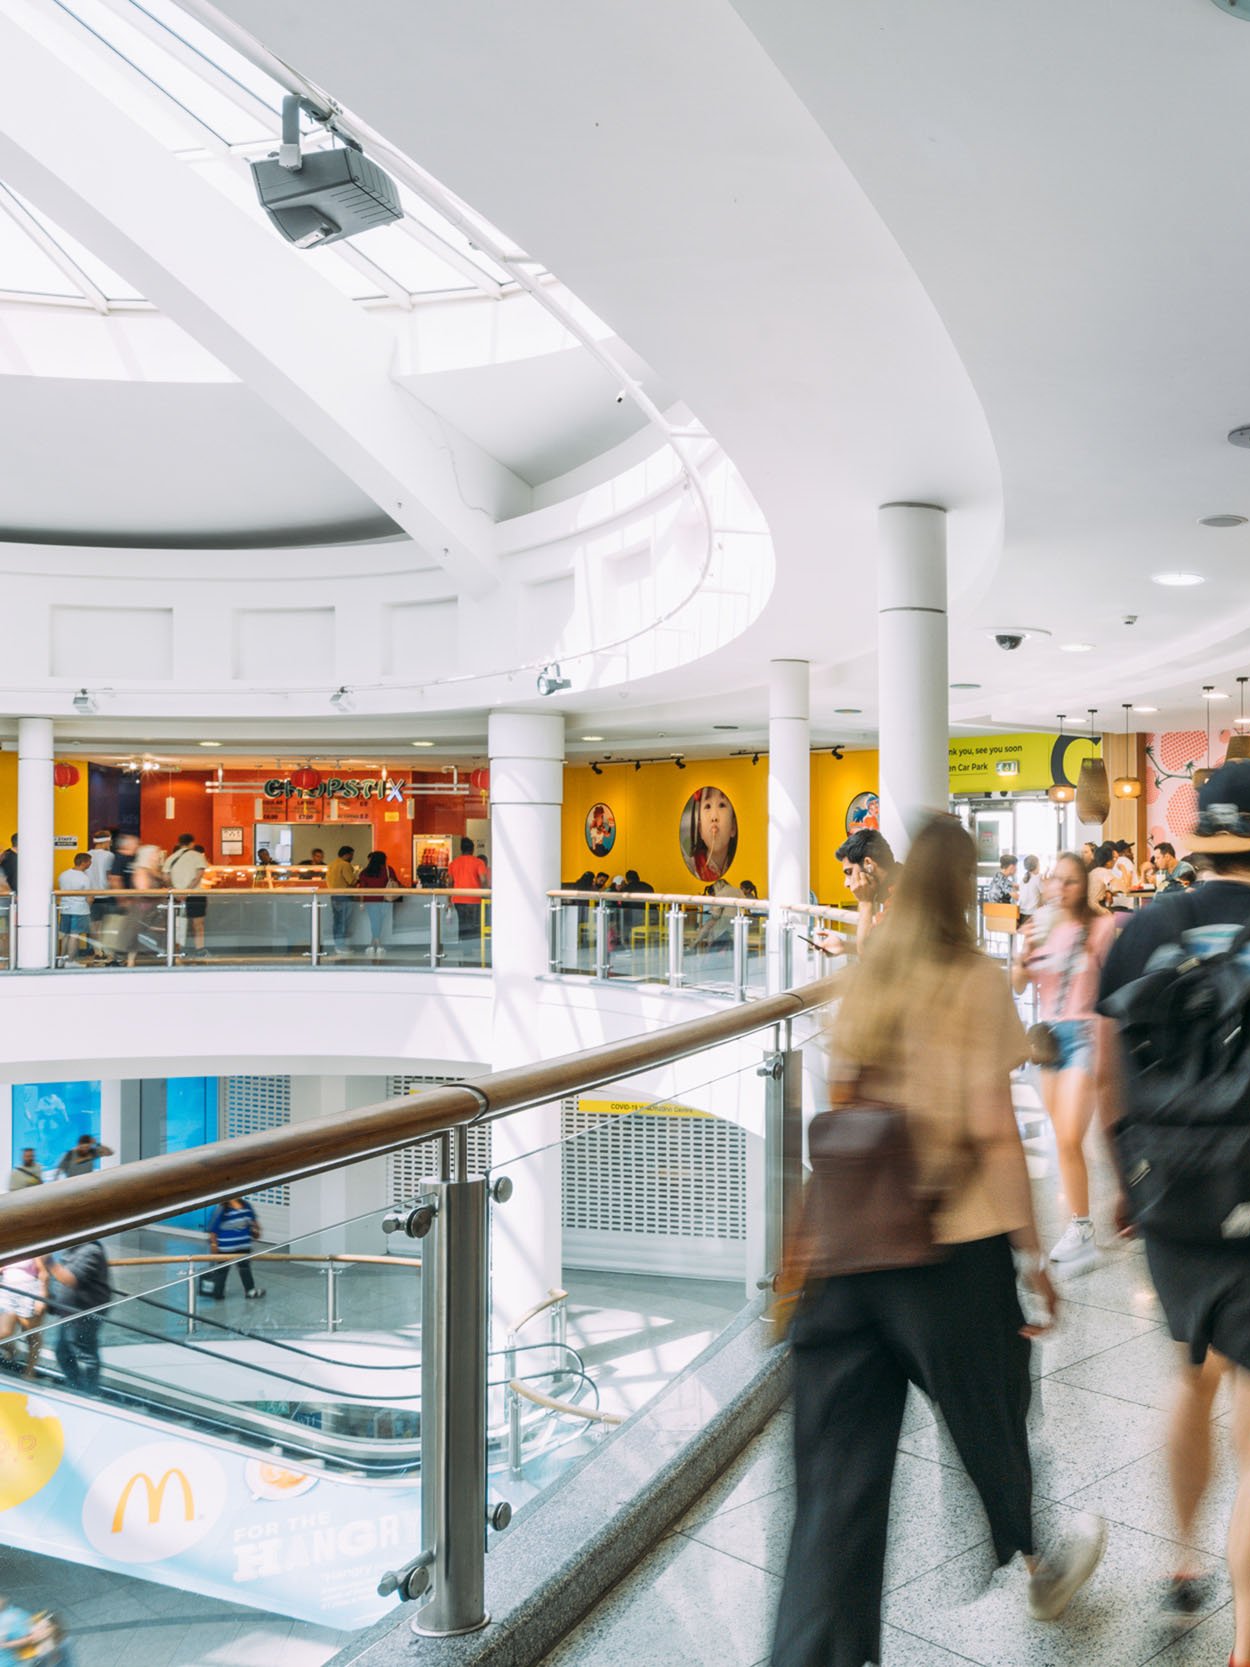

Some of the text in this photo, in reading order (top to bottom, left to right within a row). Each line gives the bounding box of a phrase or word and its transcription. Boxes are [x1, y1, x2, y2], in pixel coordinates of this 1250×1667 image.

[958, 748, 974, 757] you,
[989, 747, 1003, 755] you
[1004, 745, 1023, 753] soon
[958, 763, 970, 771] Car
[972, 762, 988, 770] Park
[233, 1511, 332, 1543] FOR THE
